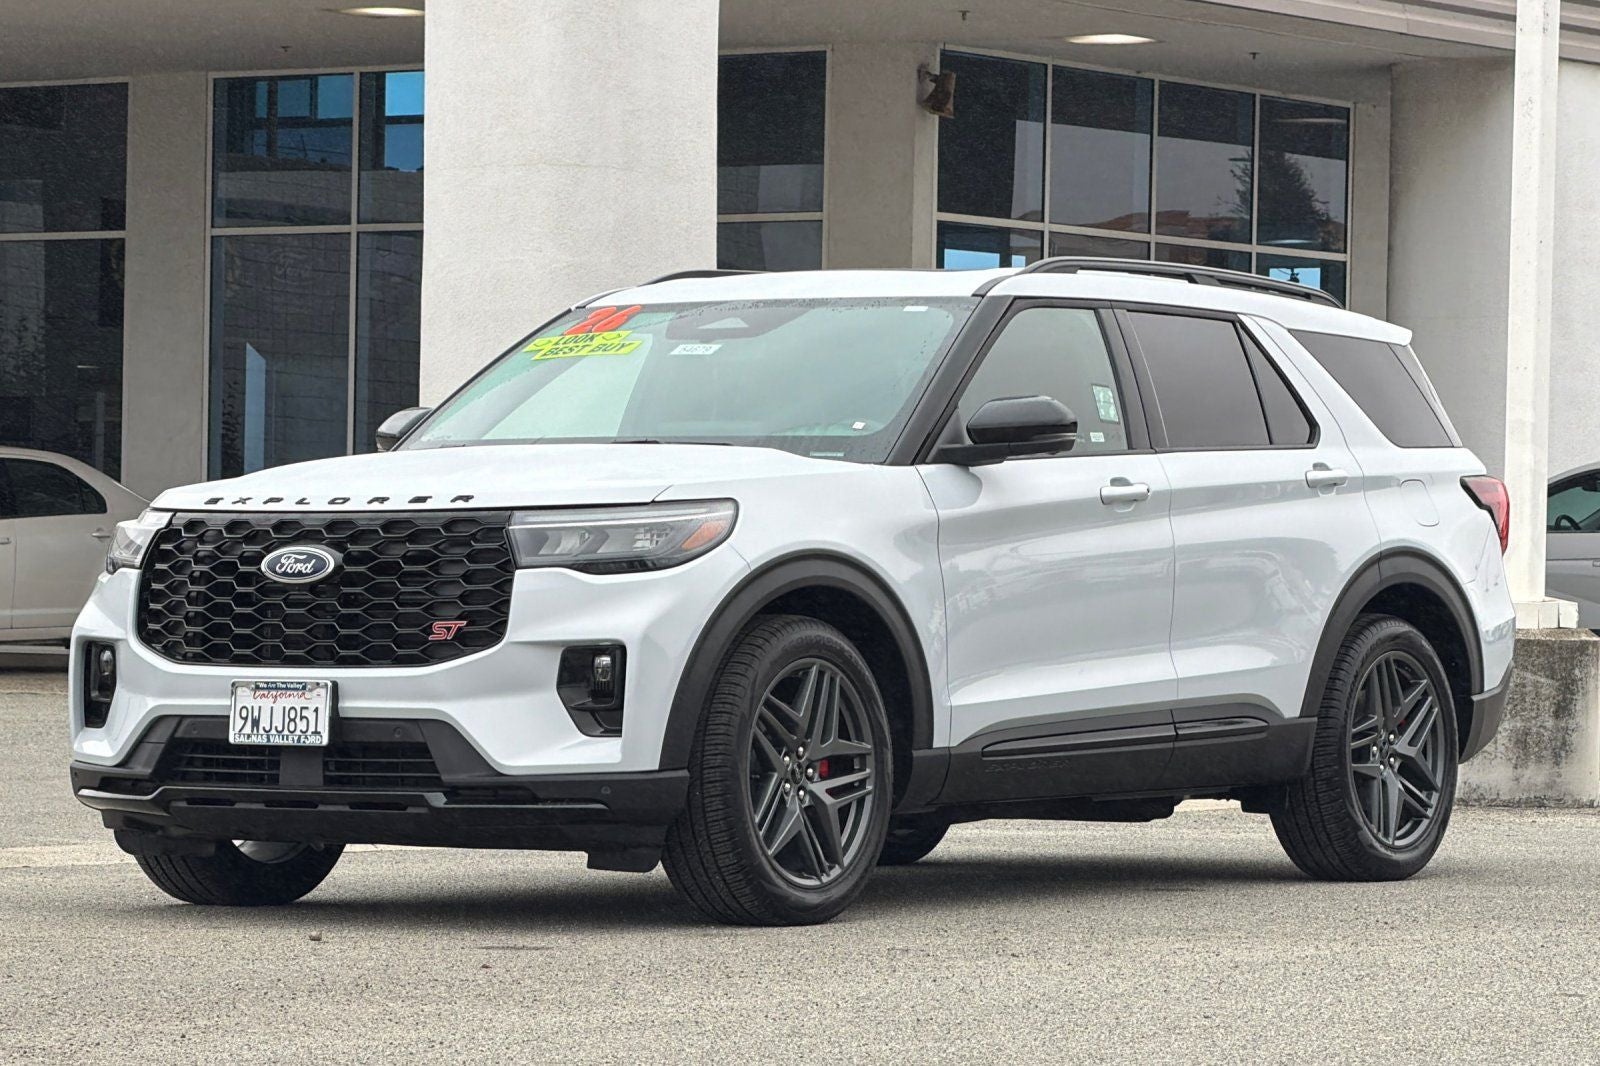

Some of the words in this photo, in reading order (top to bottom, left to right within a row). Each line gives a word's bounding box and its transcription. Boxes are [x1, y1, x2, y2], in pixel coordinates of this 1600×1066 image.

[564, 304, 641, 334] 26
[554, 334, 600, 346] LOOK
[544, 345, 592, 357] BEST
[587, 342, 635, 353] BUY
[204, 494, 475, 505] EXPLORER
[275, 553, 316, 574] Ford
[428, 620, 467, 641] ST
[252, 691, 312, 704] California
[238, 705, 321, 734] 9WJJ851
[269, 735, 298, 744] VALLEY
